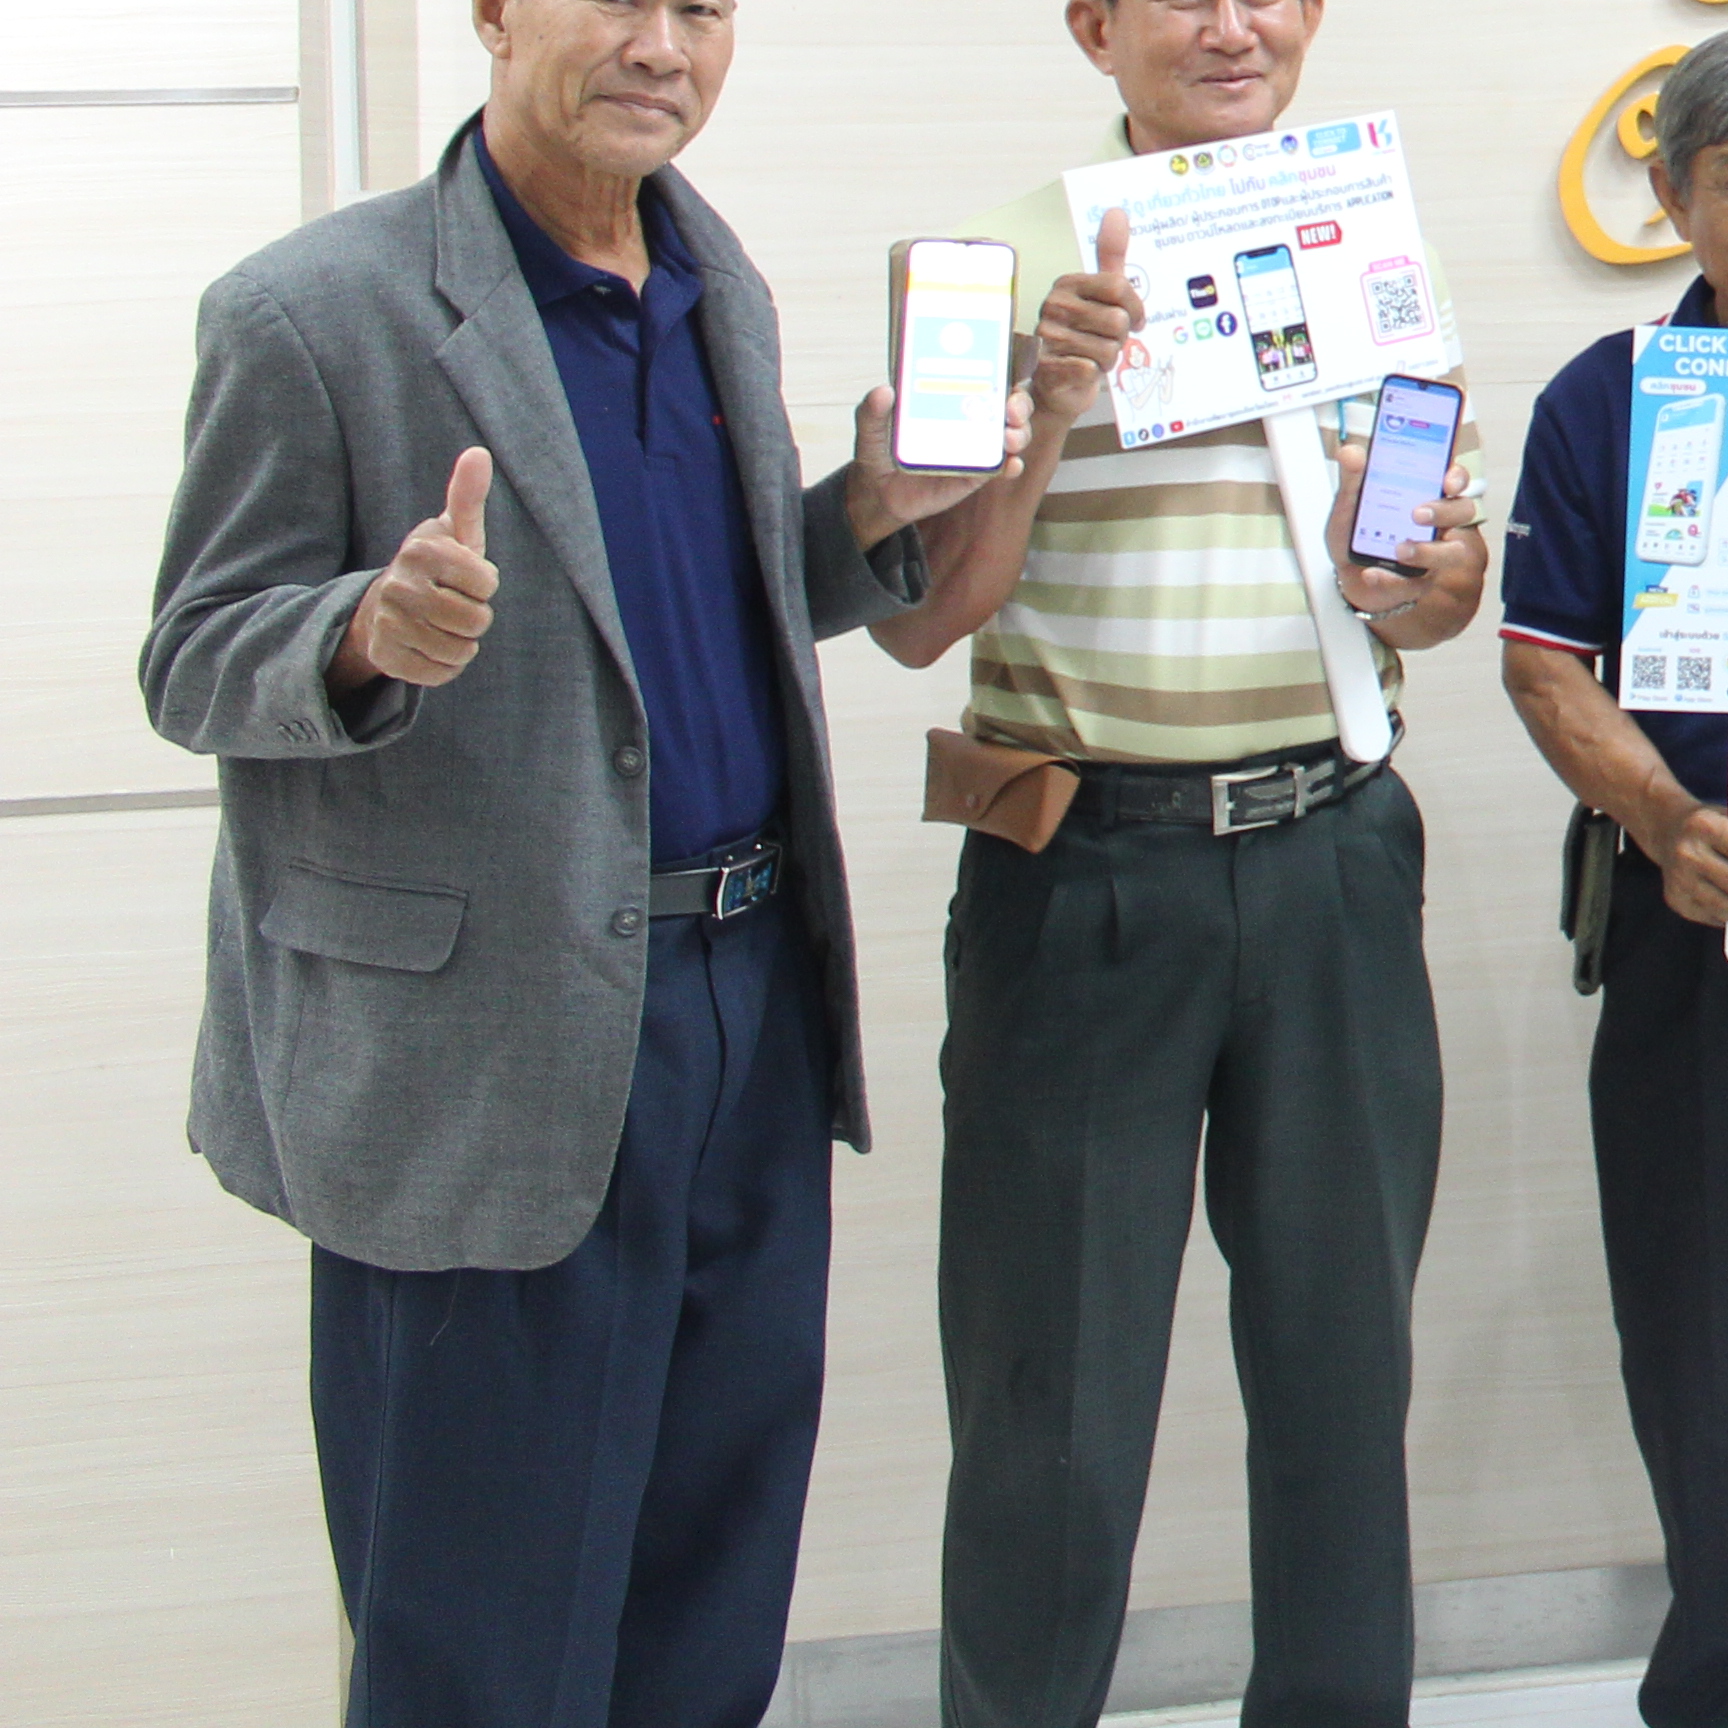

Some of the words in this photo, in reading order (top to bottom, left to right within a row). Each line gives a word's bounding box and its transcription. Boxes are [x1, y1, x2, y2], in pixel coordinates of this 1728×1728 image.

[1346, 190, 1395, 209] APPLICATION
[1300, 224, 1337, 246] NEW!
[1658, 333, 1727, 354] CLICK
[1650, 381, 1698, 395] คลิกชุมชน
